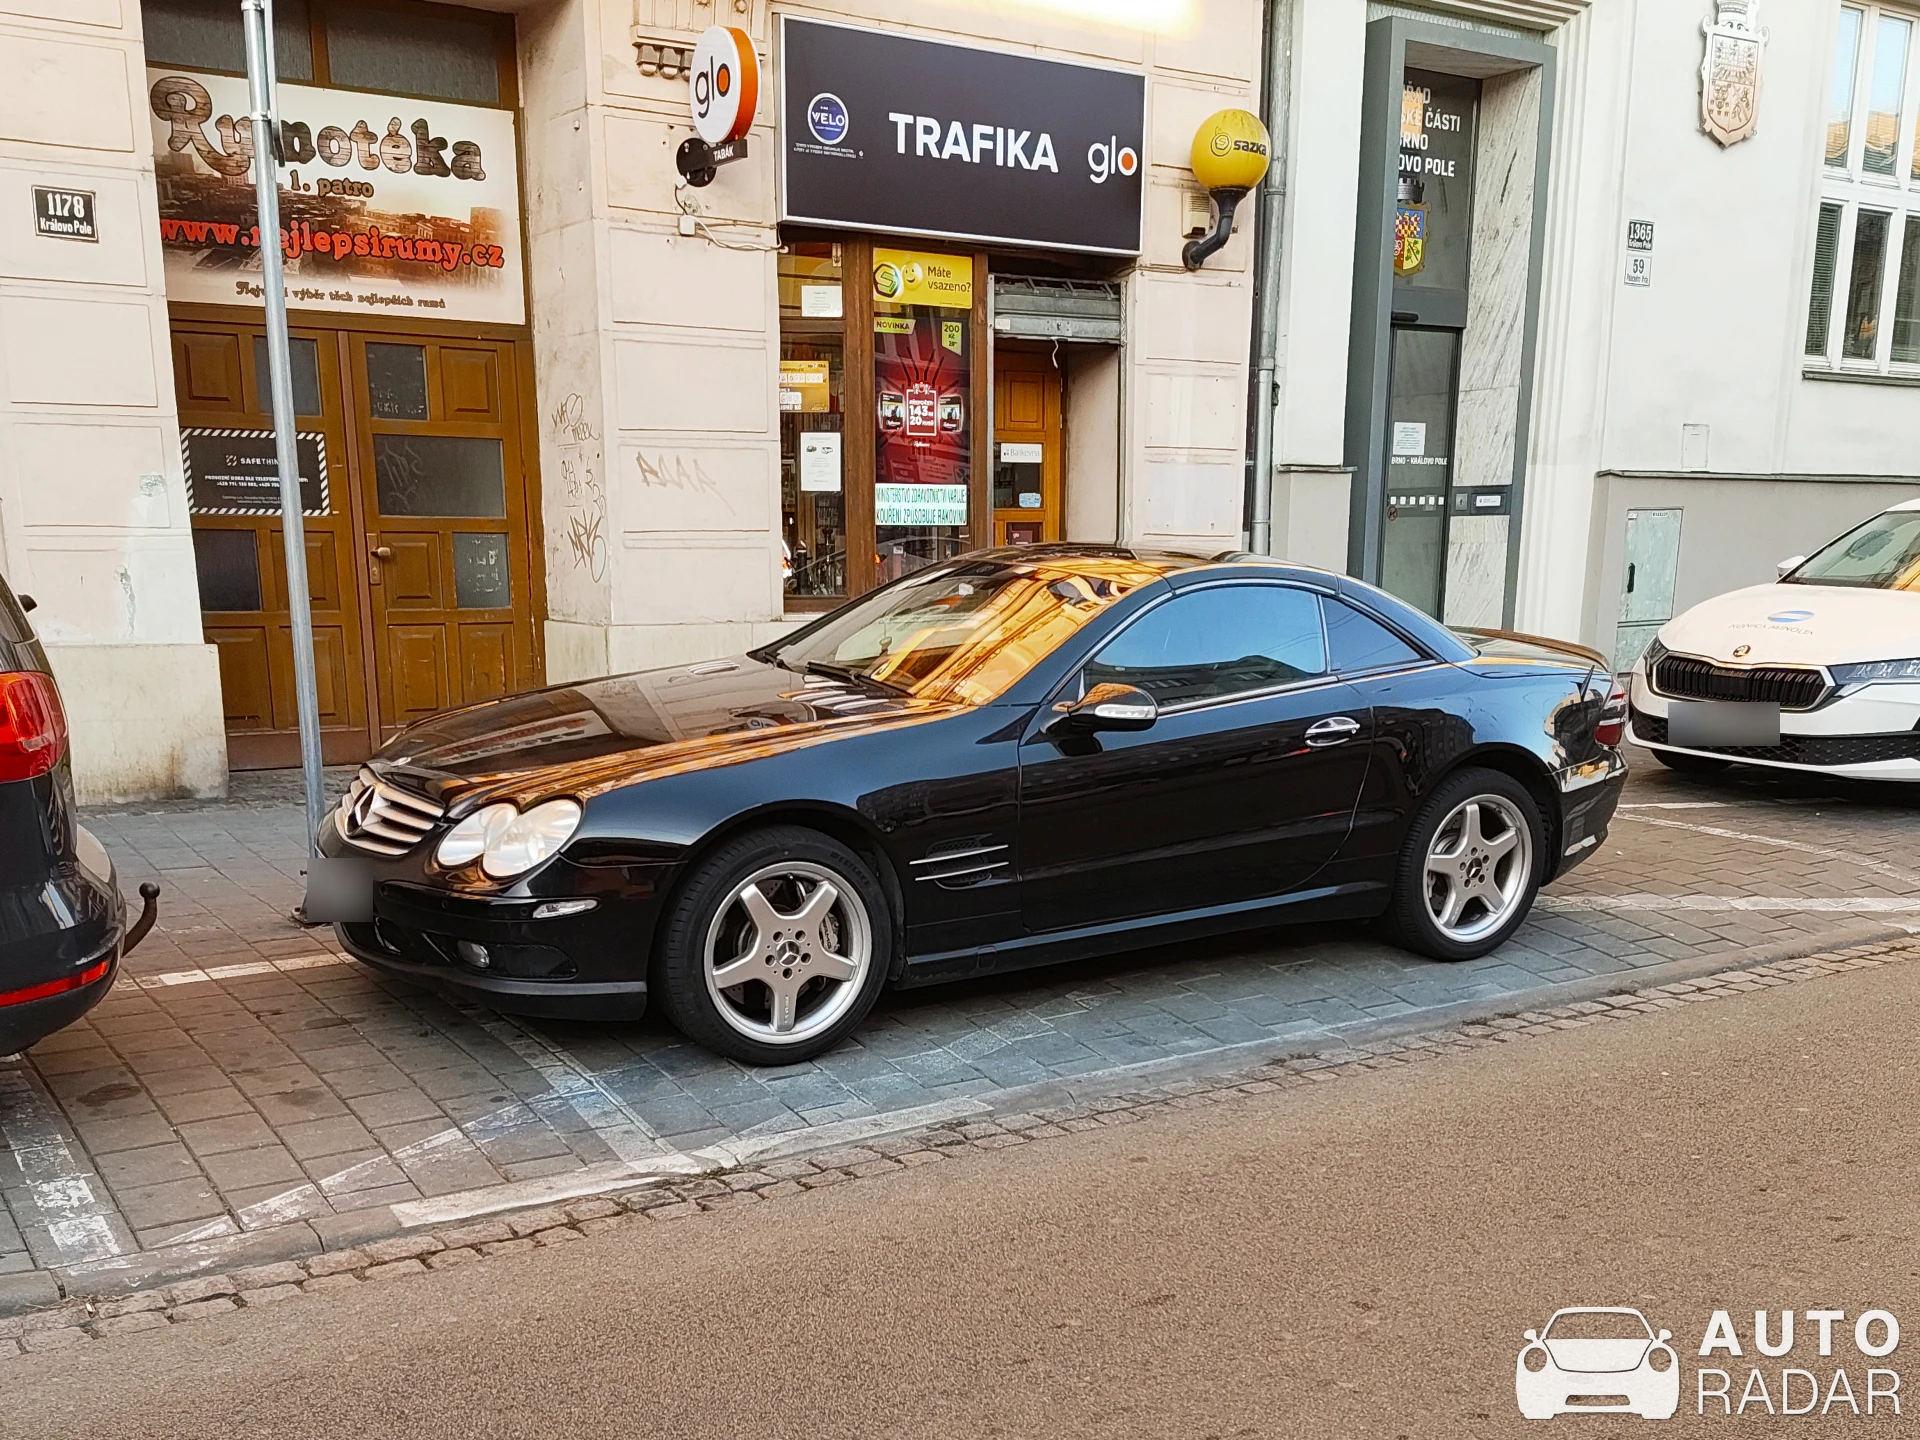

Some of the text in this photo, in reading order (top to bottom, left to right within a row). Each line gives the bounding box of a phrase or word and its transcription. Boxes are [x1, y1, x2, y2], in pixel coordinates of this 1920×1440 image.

[695, 55, 731, 119] glo
[1403, 81, 1431, 104] ŘAD
[812, 111, 845, 127] VELO
[1425, 107, 1461, 132] ČÁSTI
[888, 112, 1059, 173] TRAFIKA
[1400, 131, 1429, 150] RNO
[713, 144, 734, 162] TABÁK
[1087, 135, 1138, 184] glo
[1425, 158, 1455, 177] POLE
[317, 176, 375, 198] patro
[47, 192, 85, 218] 1178
[40, 217, 93, 235] Královo Pole
[927, 266, 952, 279] Máte
[1633, 259, 1645, 274] 59
[927, 281, 972, 293] vsazeno?
[876, 321, 910, 330] NOVINKA
[944, 324, 960, 333] 200
[909, 405, 928, 417] 143
[909, 416, 922, 426] 20
